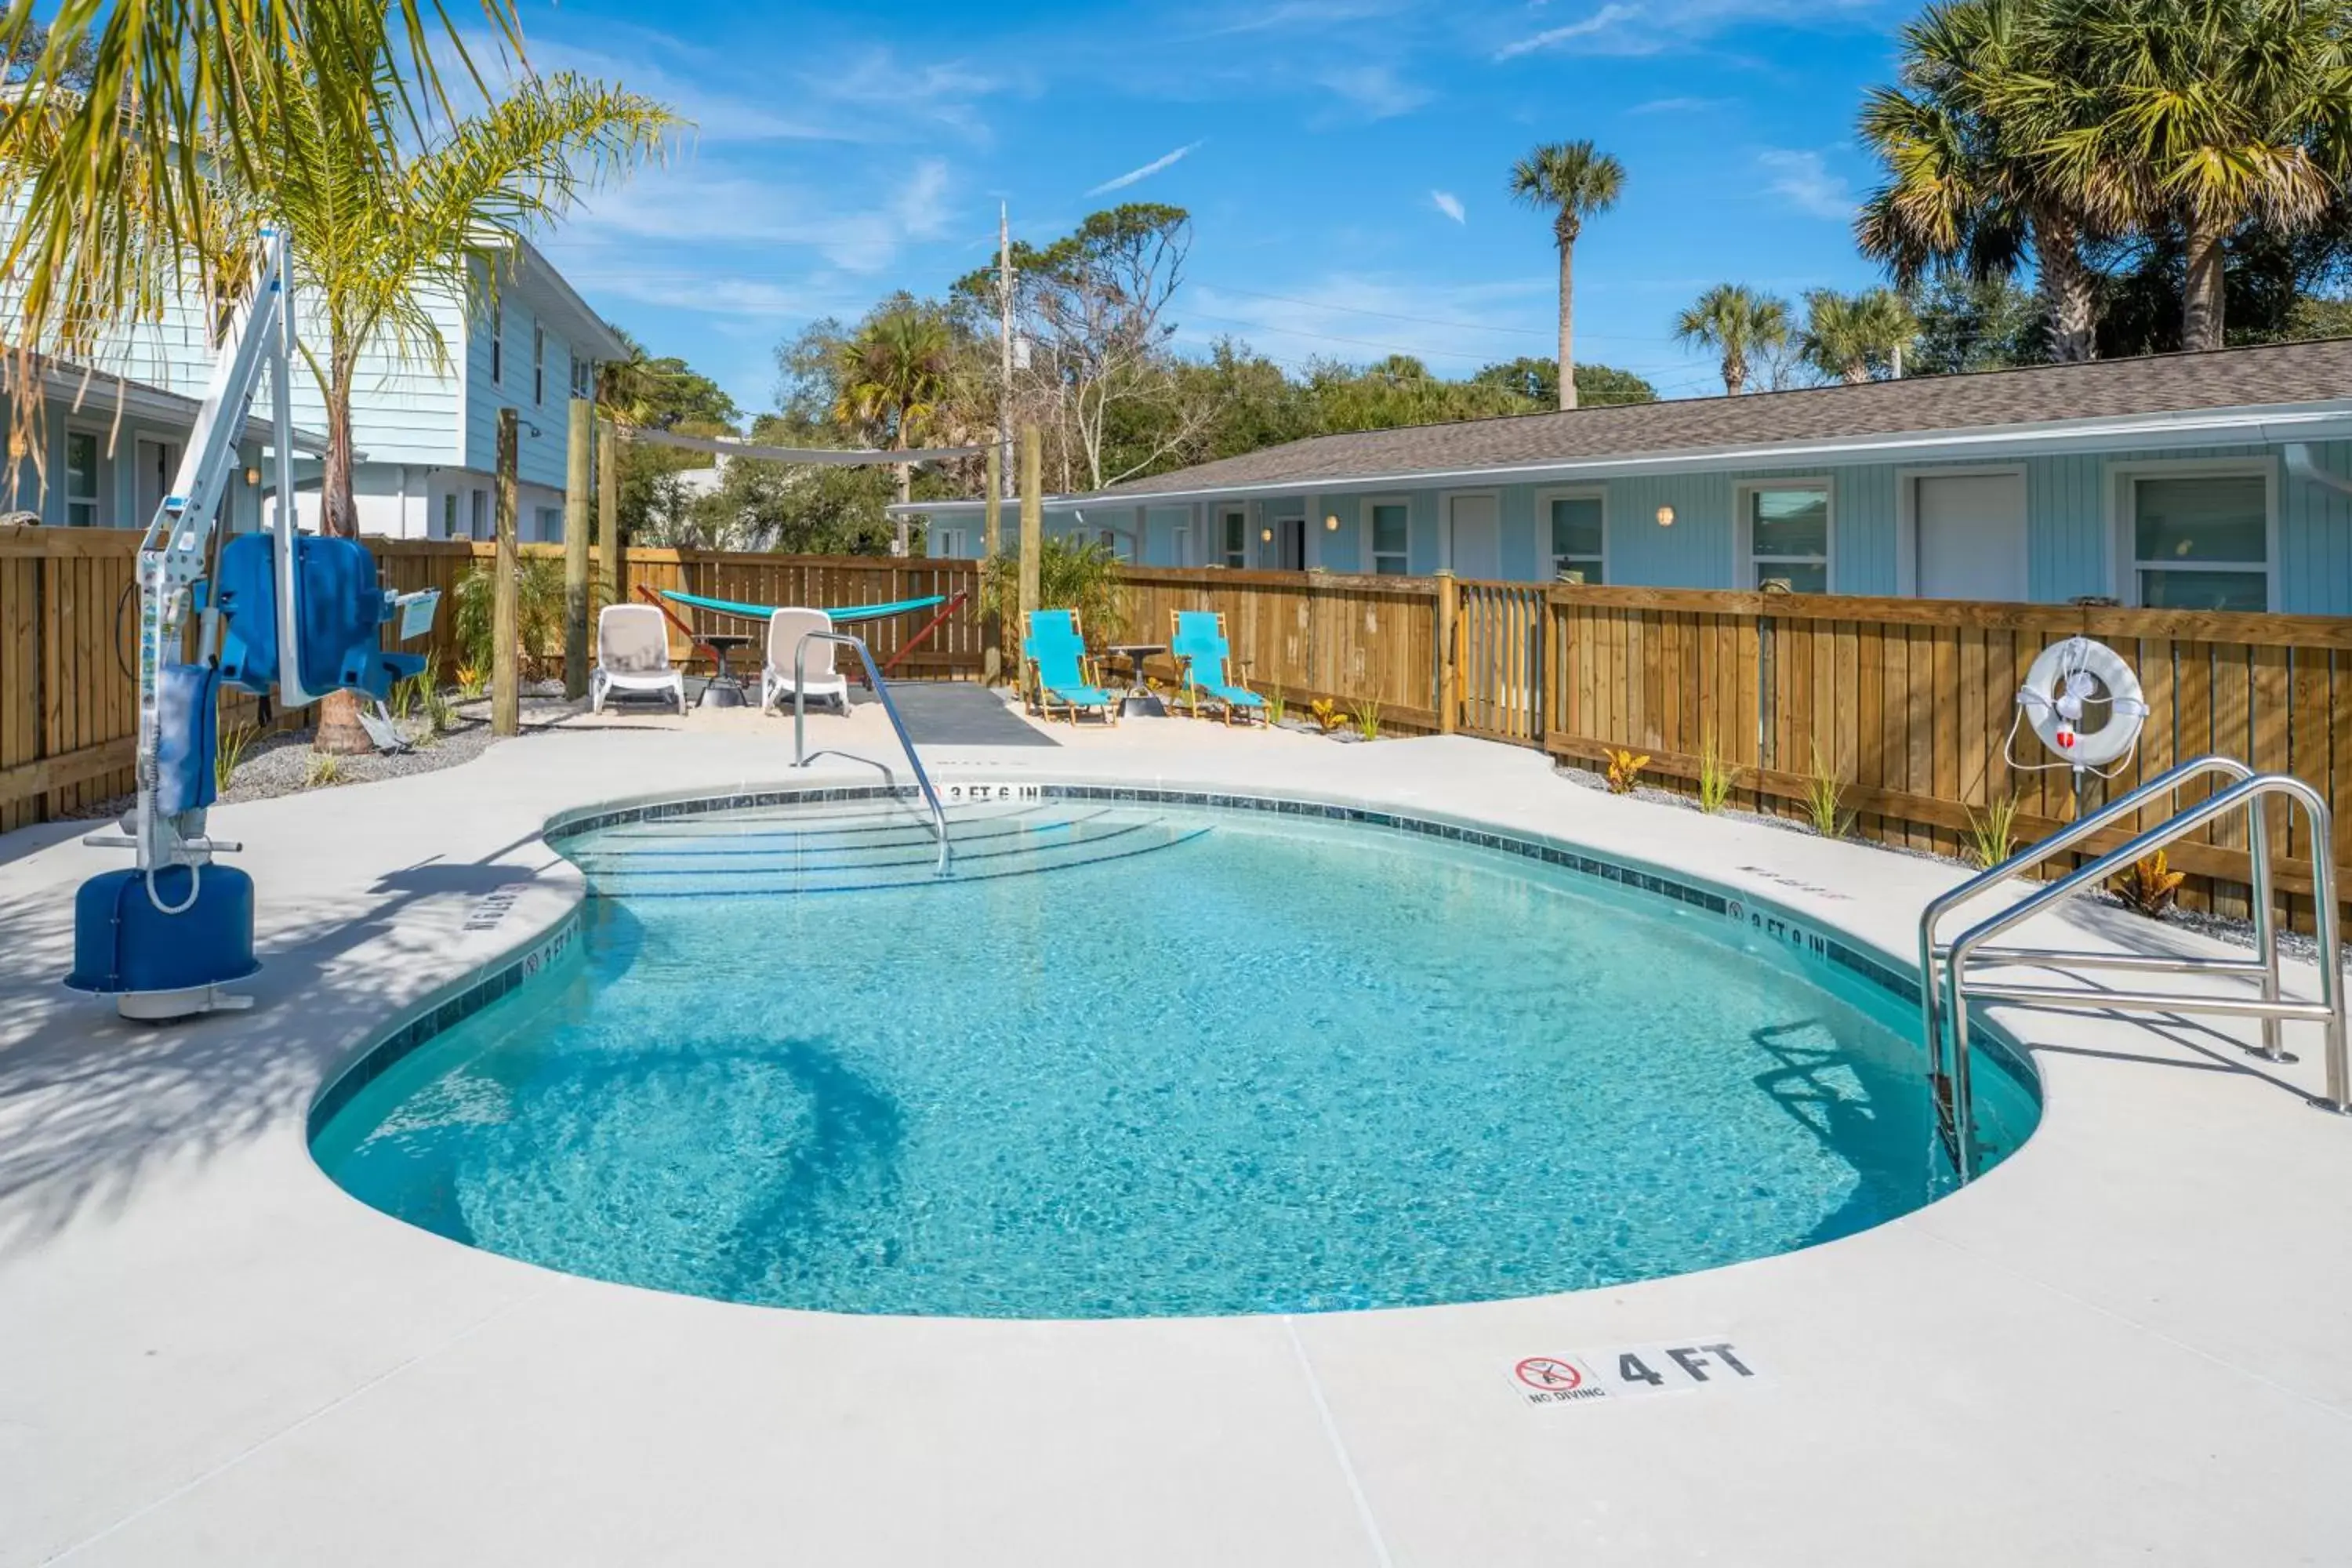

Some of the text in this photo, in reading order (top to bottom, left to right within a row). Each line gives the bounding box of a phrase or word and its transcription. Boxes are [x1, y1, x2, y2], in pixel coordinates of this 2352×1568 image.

[969, 786, 990, 800] FT
[1018, 786, 1037, 800] IN
[1767, 917, 1785, 937] FT
[1809, 934, 1824, 954] IN
[1618, 1343, 1755, 1386] 4 FT
[1530, 1385, 1606, 1404] NO DIVING
